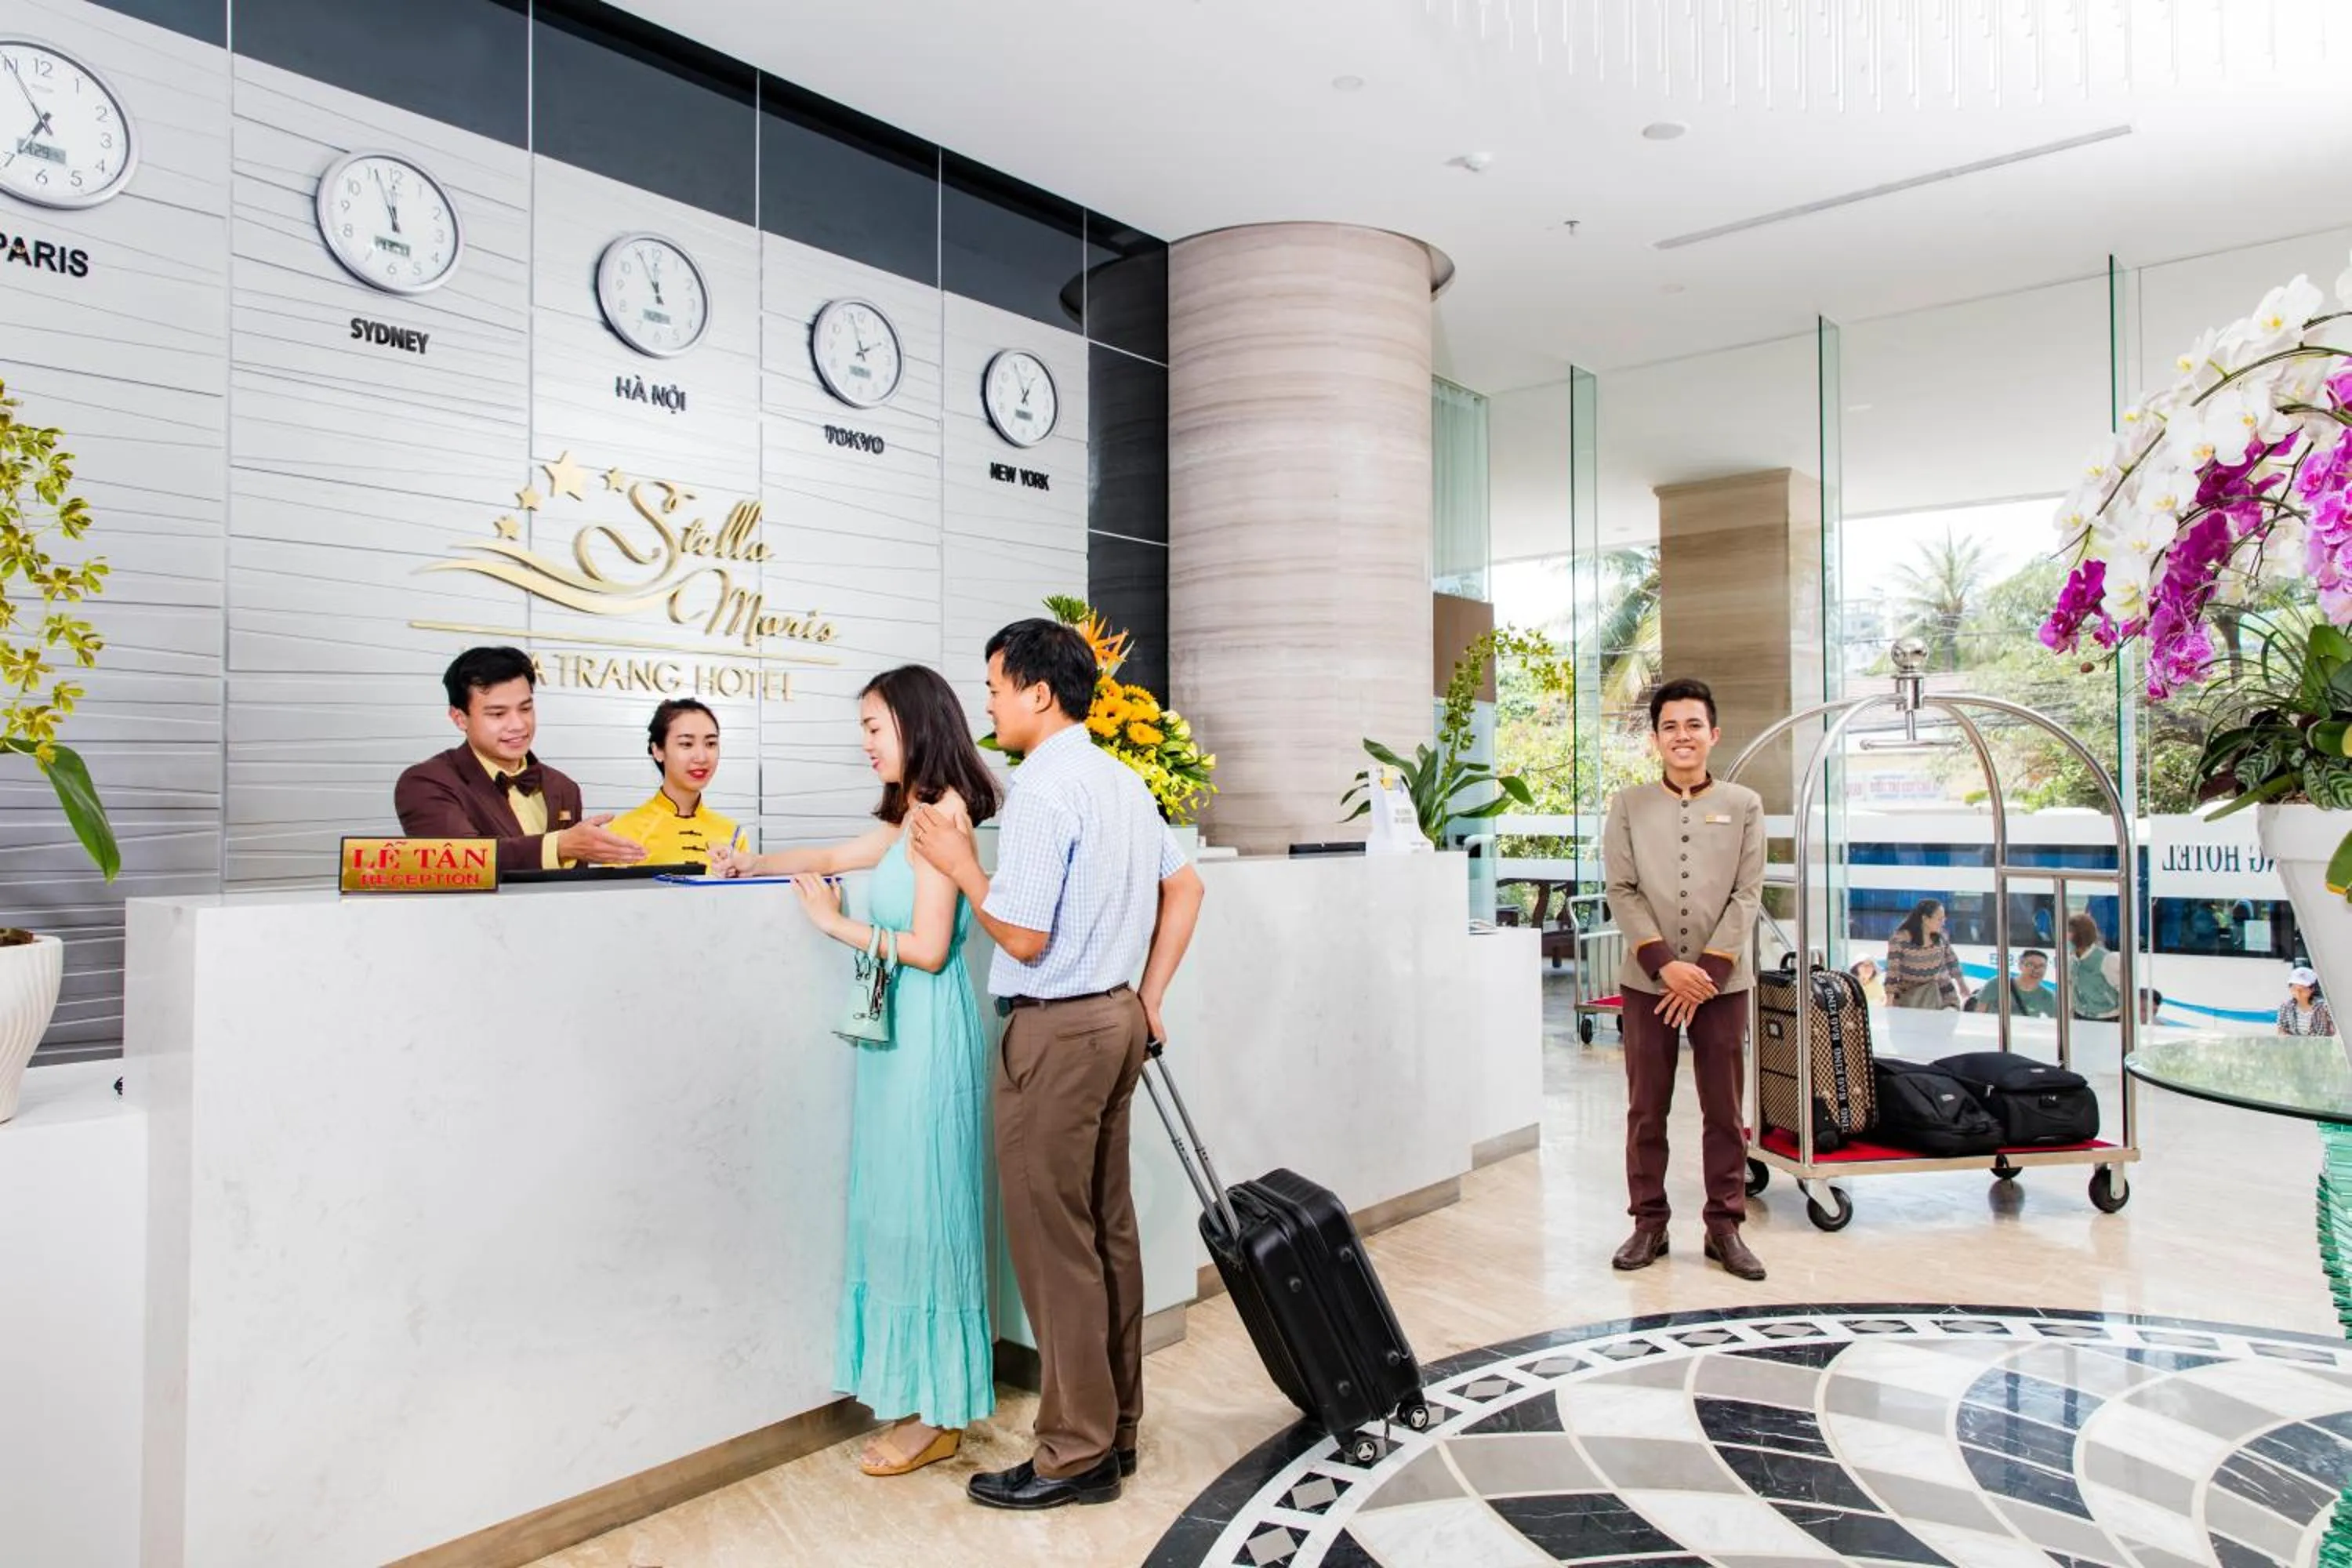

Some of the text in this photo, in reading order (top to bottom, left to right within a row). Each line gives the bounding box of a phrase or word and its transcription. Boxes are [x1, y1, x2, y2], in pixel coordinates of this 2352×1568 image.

[34, 58, 53, 77] 12
[95, 105, 107, 122] 2
[100, 132, 112, 149] 3
[3, 152, 15, 167] 7
[95, 158, 106, 174] 4
[35, 169, 48, 186] 6
[71, 170, 82, 187] 5
[389, 168, 402, 184] 12
[348, 177, 361, 196] 10
[340, 199, 350, 213] 9
[432, 207, 442, 221] 2
[343, 223, 353, 238] 8
[436, 230, 445, 244] 3
[431, 252, 439, 263] 4
[387, 262, 397, 275] 6
[413, 262, 423, 276] 5
[350, 318, 430, 354] SYDNEY
[615, 374, 686, 414] HÀ NỘI
[824, 424, 884, 455] TOKYO
[990, 462, 1050, 491] NEW YORK
[573, 480, 773, 586] Stella
[667, 568, 839, 647] Maris
[553, 654, 681, 694] TRANG
[695, 664, 795, 702] HOTEL
[353, 841, 488, 869] LỄ TÂN
[361, 872, 480, 887] RECEPTION
